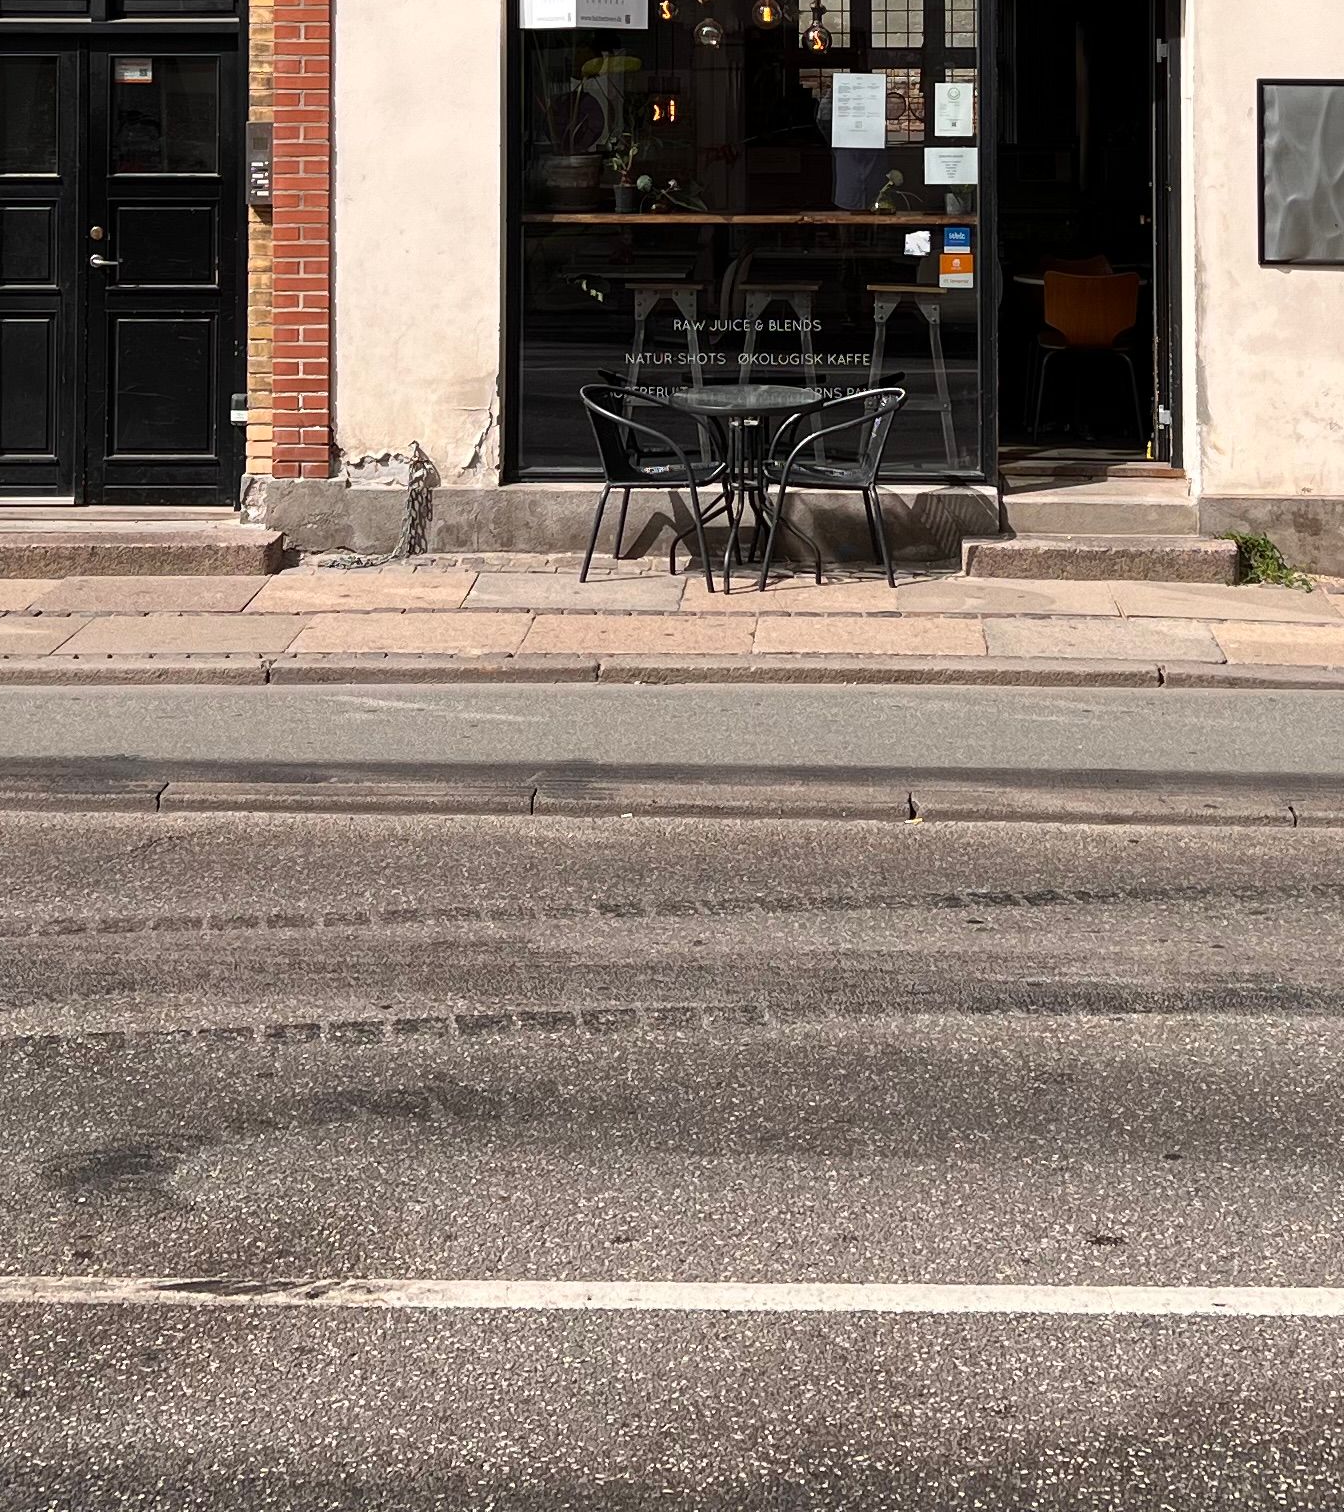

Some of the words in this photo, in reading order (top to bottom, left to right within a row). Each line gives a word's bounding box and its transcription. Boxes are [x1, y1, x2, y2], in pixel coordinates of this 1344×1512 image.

[673, 319, 706, 331] RAW
[709, 319, 751, 331] JUICE
[754, 320, 764, 331] &
[768, 319, 822, 331] BLENDS
[737, 352, 823, 365] ØKOLOGISK
[827, 353, 871, 366] KAFFE
